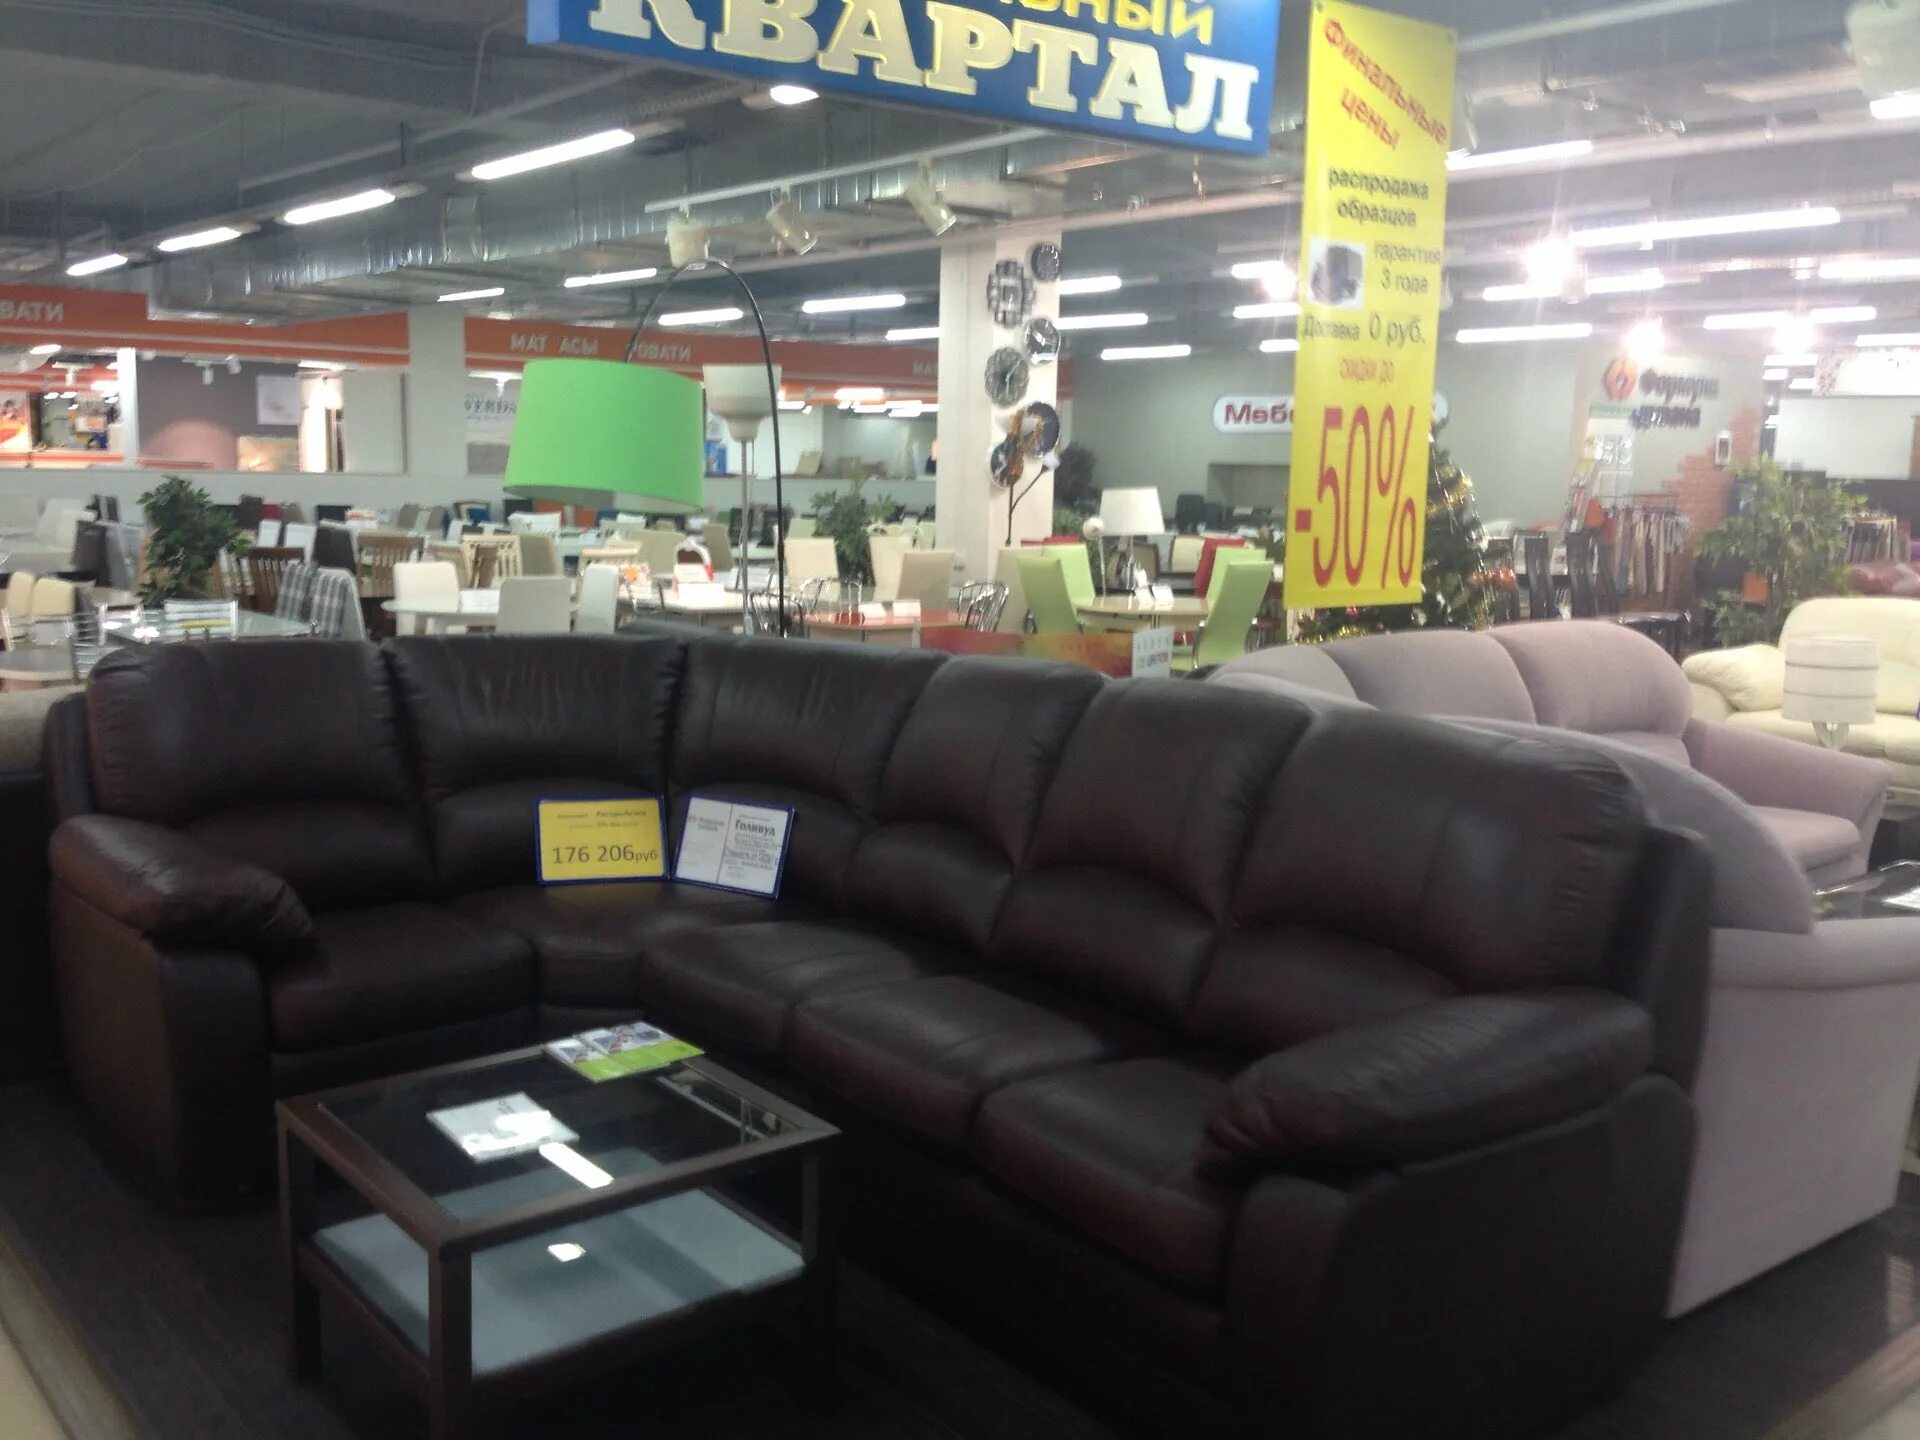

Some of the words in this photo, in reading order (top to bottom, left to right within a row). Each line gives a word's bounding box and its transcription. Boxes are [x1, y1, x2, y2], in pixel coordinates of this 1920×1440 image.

[1323, 17, 1448, 146] Финальные
[1341, 87, 1401, 151] цены
[1327, 166, 1430, 201] распродажа
[1336, 199, 1418, 229] образцов
[1374, 240, 1441, 266] гарантия
[1380, 266, 1391, 290] 3
[1396, 273, 1429, 297] года
[1368, 311, 1382, 341] 0
[1224, 401, 1294, 426] Меб
[1295, 405, 1417, 591] -50%
[552, 846, 590, 865] 176
